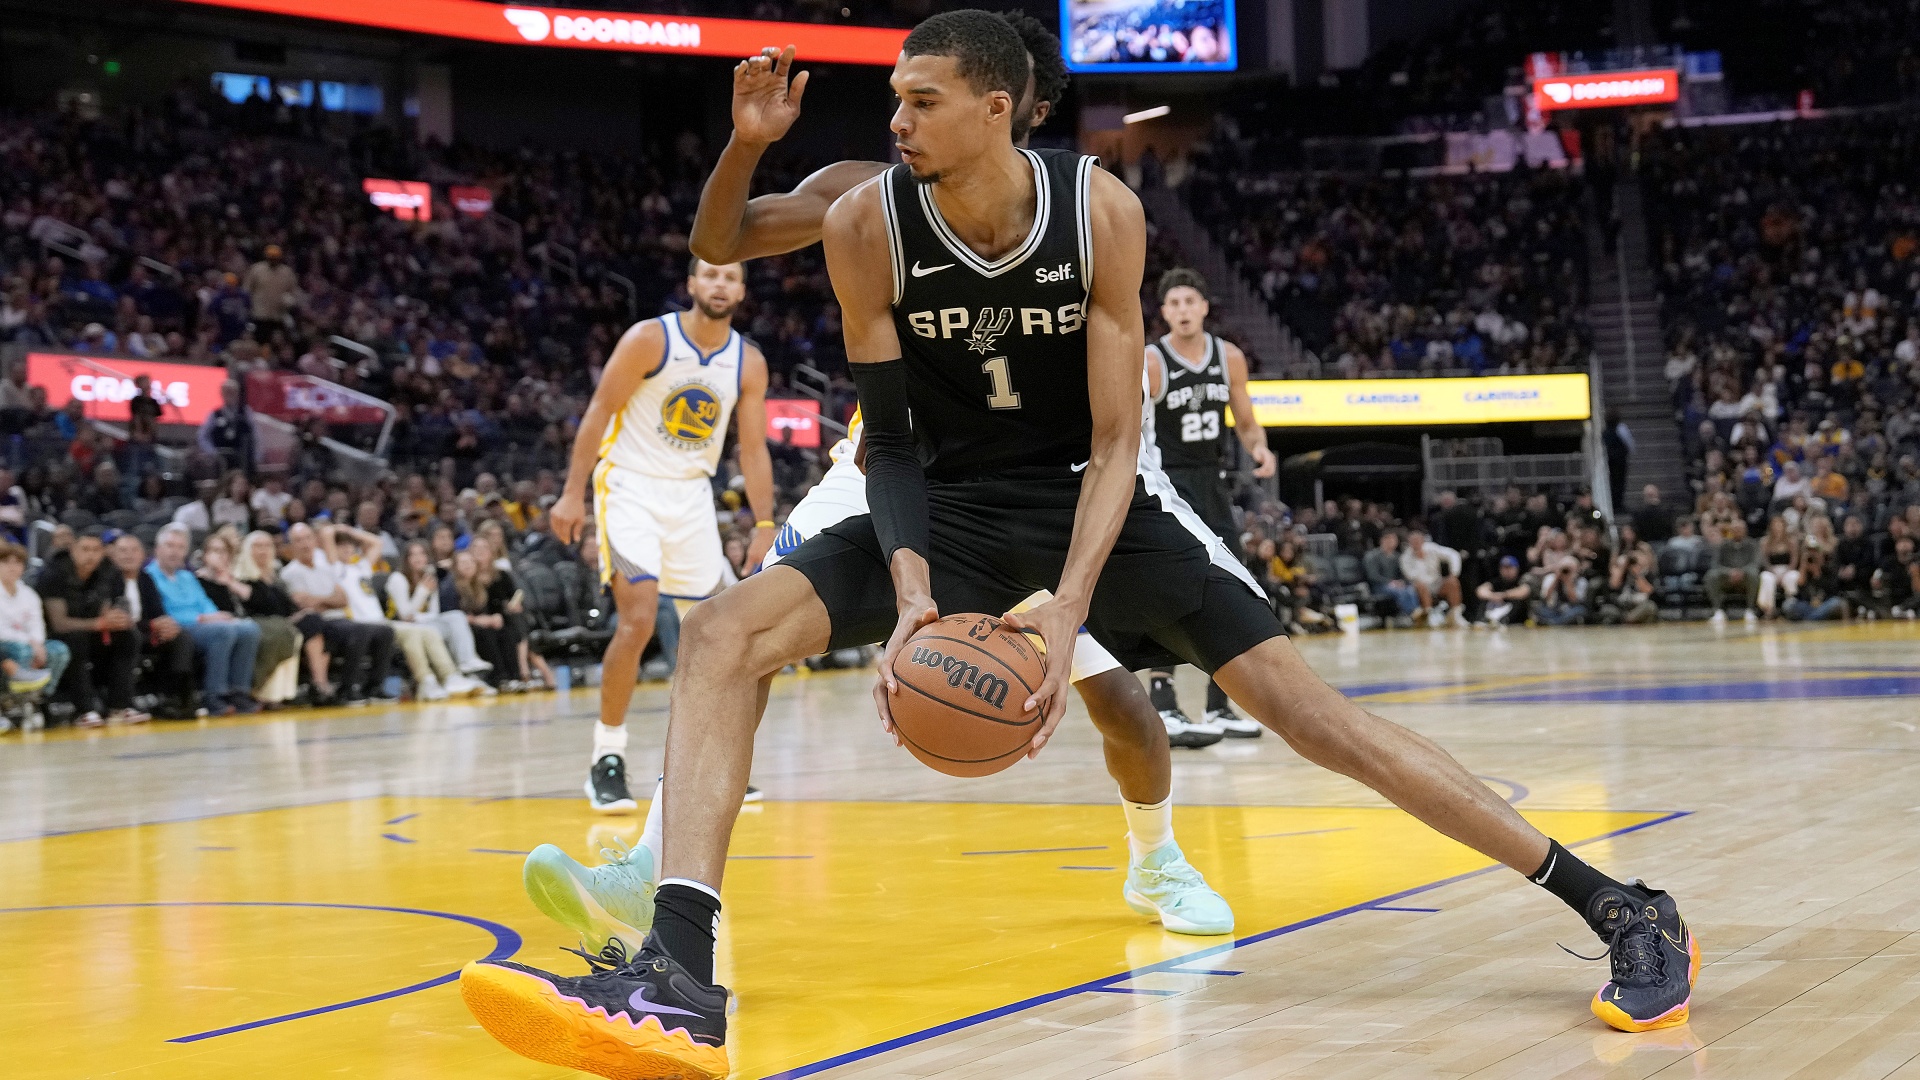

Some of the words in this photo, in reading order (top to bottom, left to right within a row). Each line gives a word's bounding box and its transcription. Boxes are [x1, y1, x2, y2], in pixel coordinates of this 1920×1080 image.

[554, 15, 701, 48] DOORDASH
[1572, 78, 1665, 100] DOORDASH
[907, 302, 1083, 352] SPURS
[71, 374, 190, 407] ORALE
[981, 355, 1022, 411] 1
[1166, 383, 1230, 411] SPURS
[696, 400, 717, 421] 30
[1181, 410, 1220, 443] 23
[911, 646, 1010, 711] Wilson
